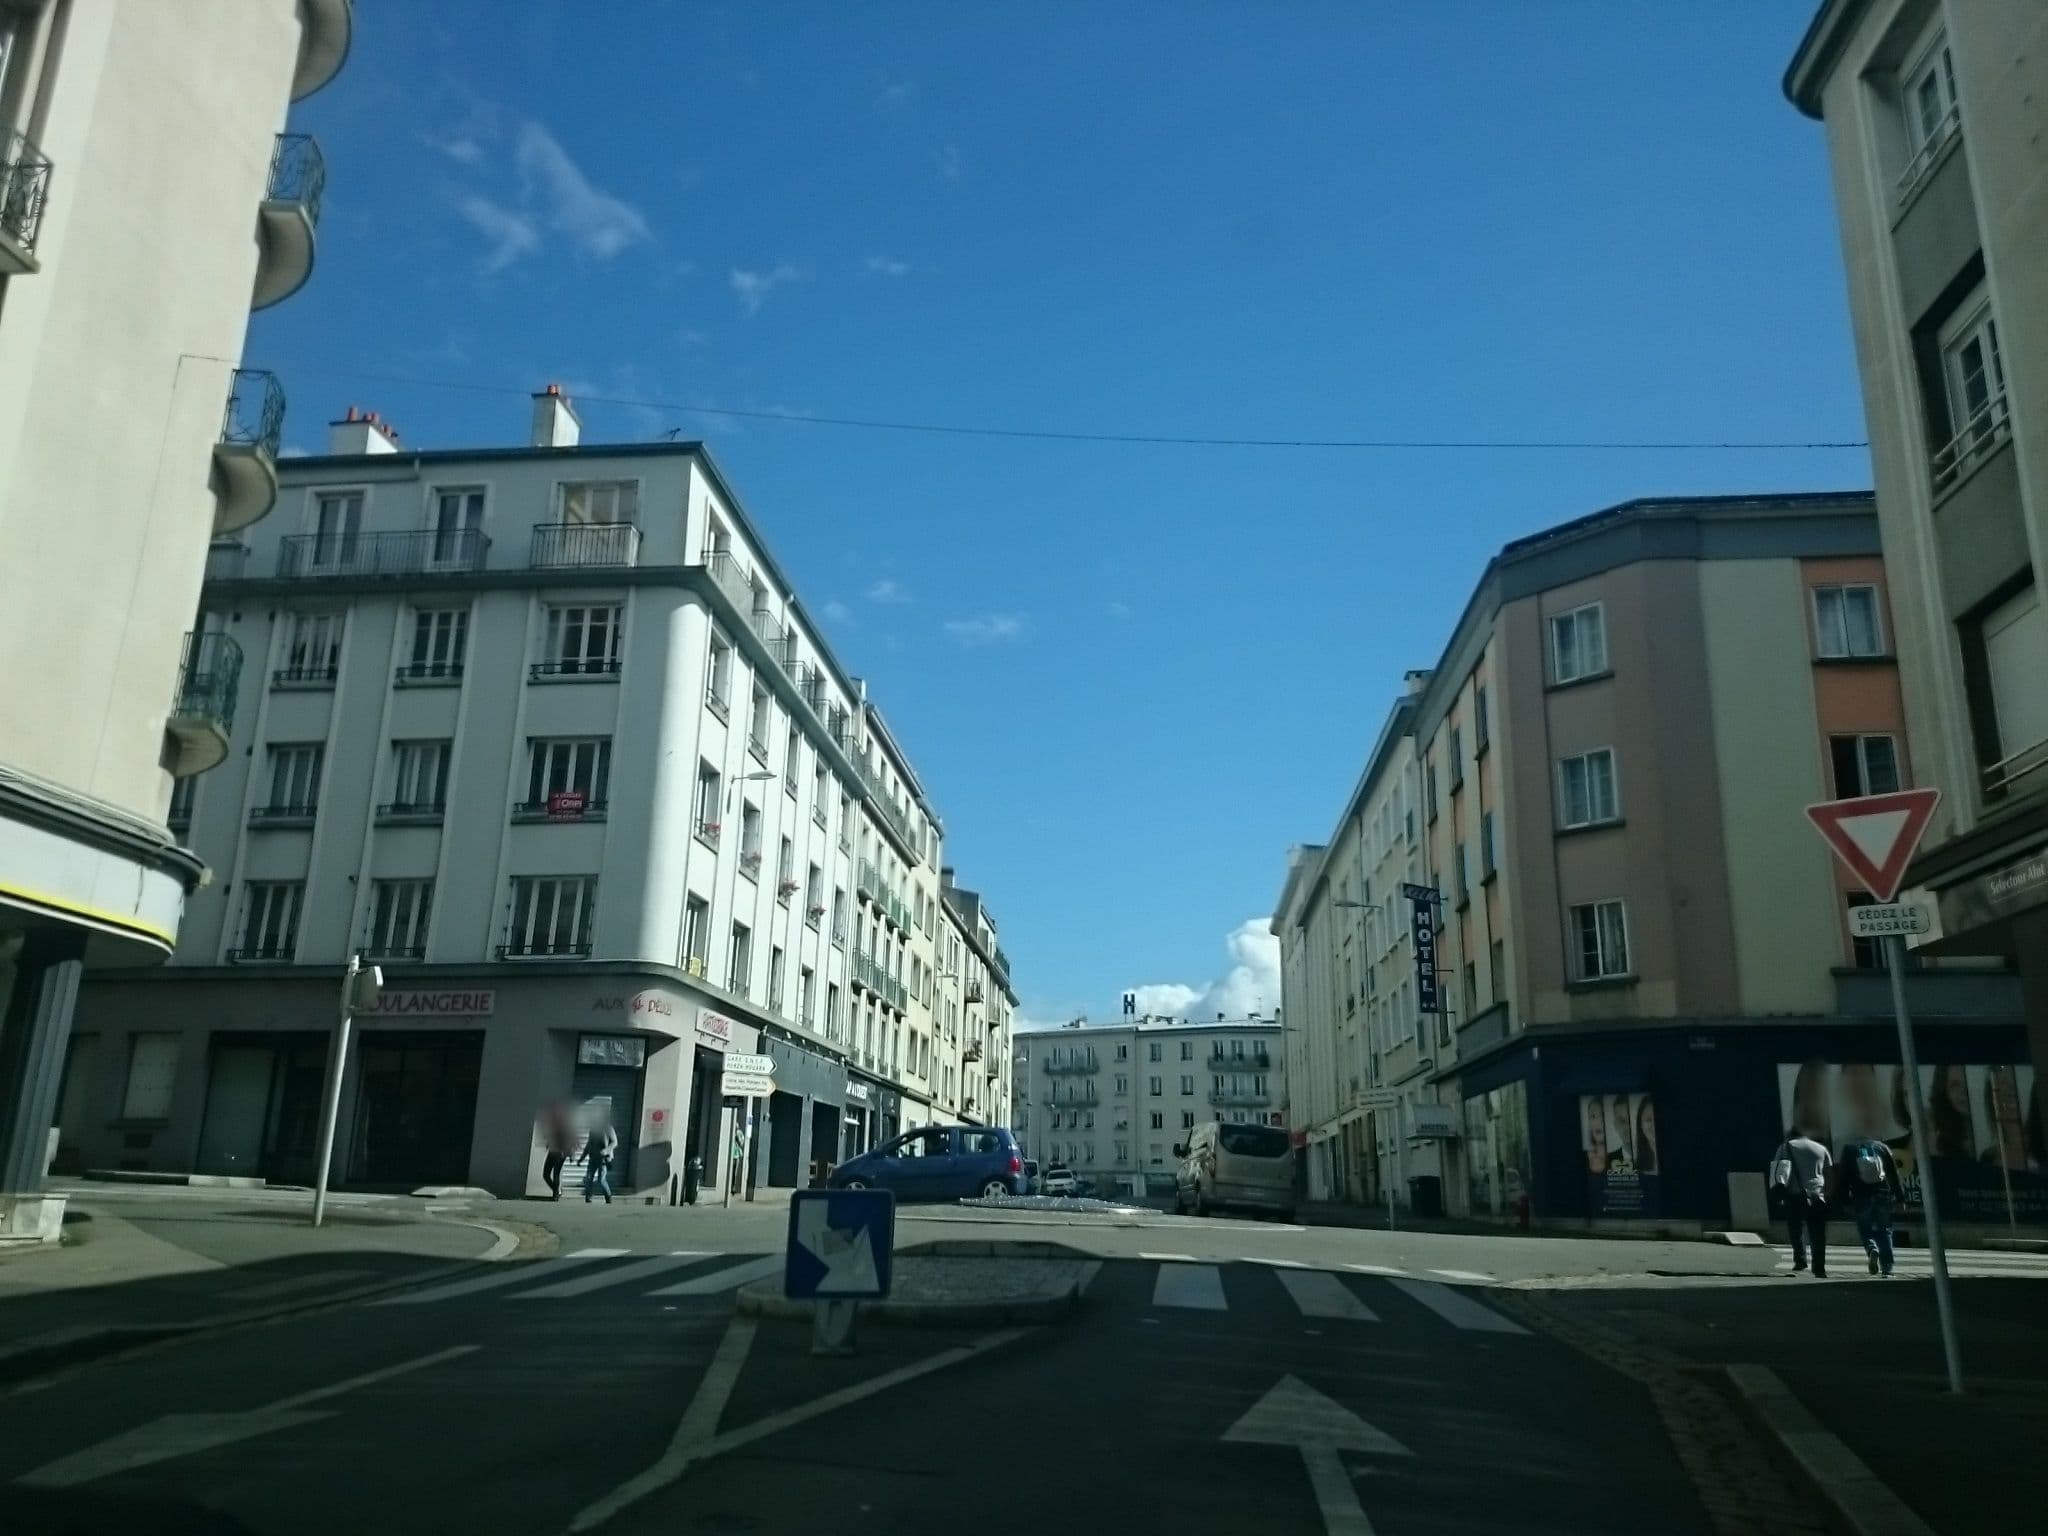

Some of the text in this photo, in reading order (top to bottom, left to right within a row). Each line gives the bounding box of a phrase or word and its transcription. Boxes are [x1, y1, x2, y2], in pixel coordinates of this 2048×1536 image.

[1857, 907, 1917, 920] CÉDEZ LE
[1860, 920, 1918, 932] PASSAGE
[1416, 911, 1434, 993] HOTEL
[366, 992, 491, 1013] OULANGERIE
